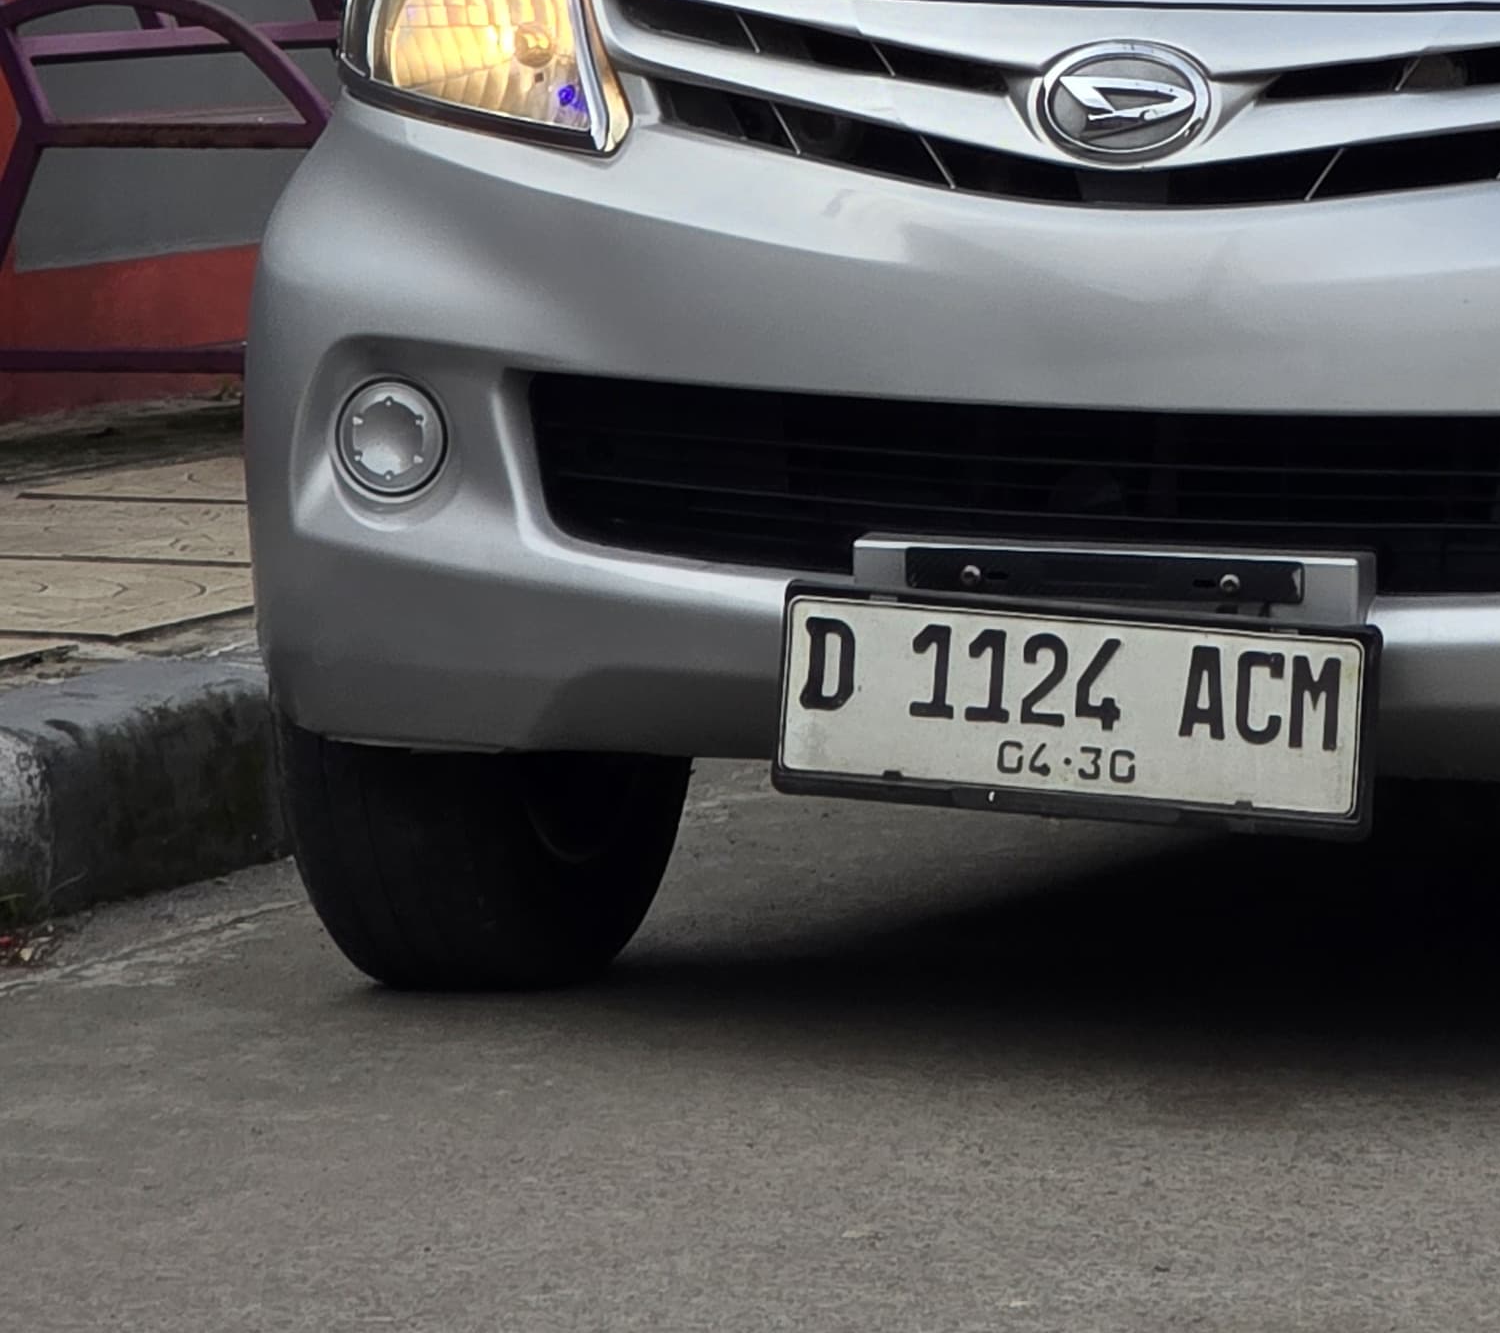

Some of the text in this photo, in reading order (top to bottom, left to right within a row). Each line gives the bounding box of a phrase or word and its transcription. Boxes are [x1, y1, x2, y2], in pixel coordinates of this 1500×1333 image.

[799, 616, 1342, 752] D 1124 ACM
